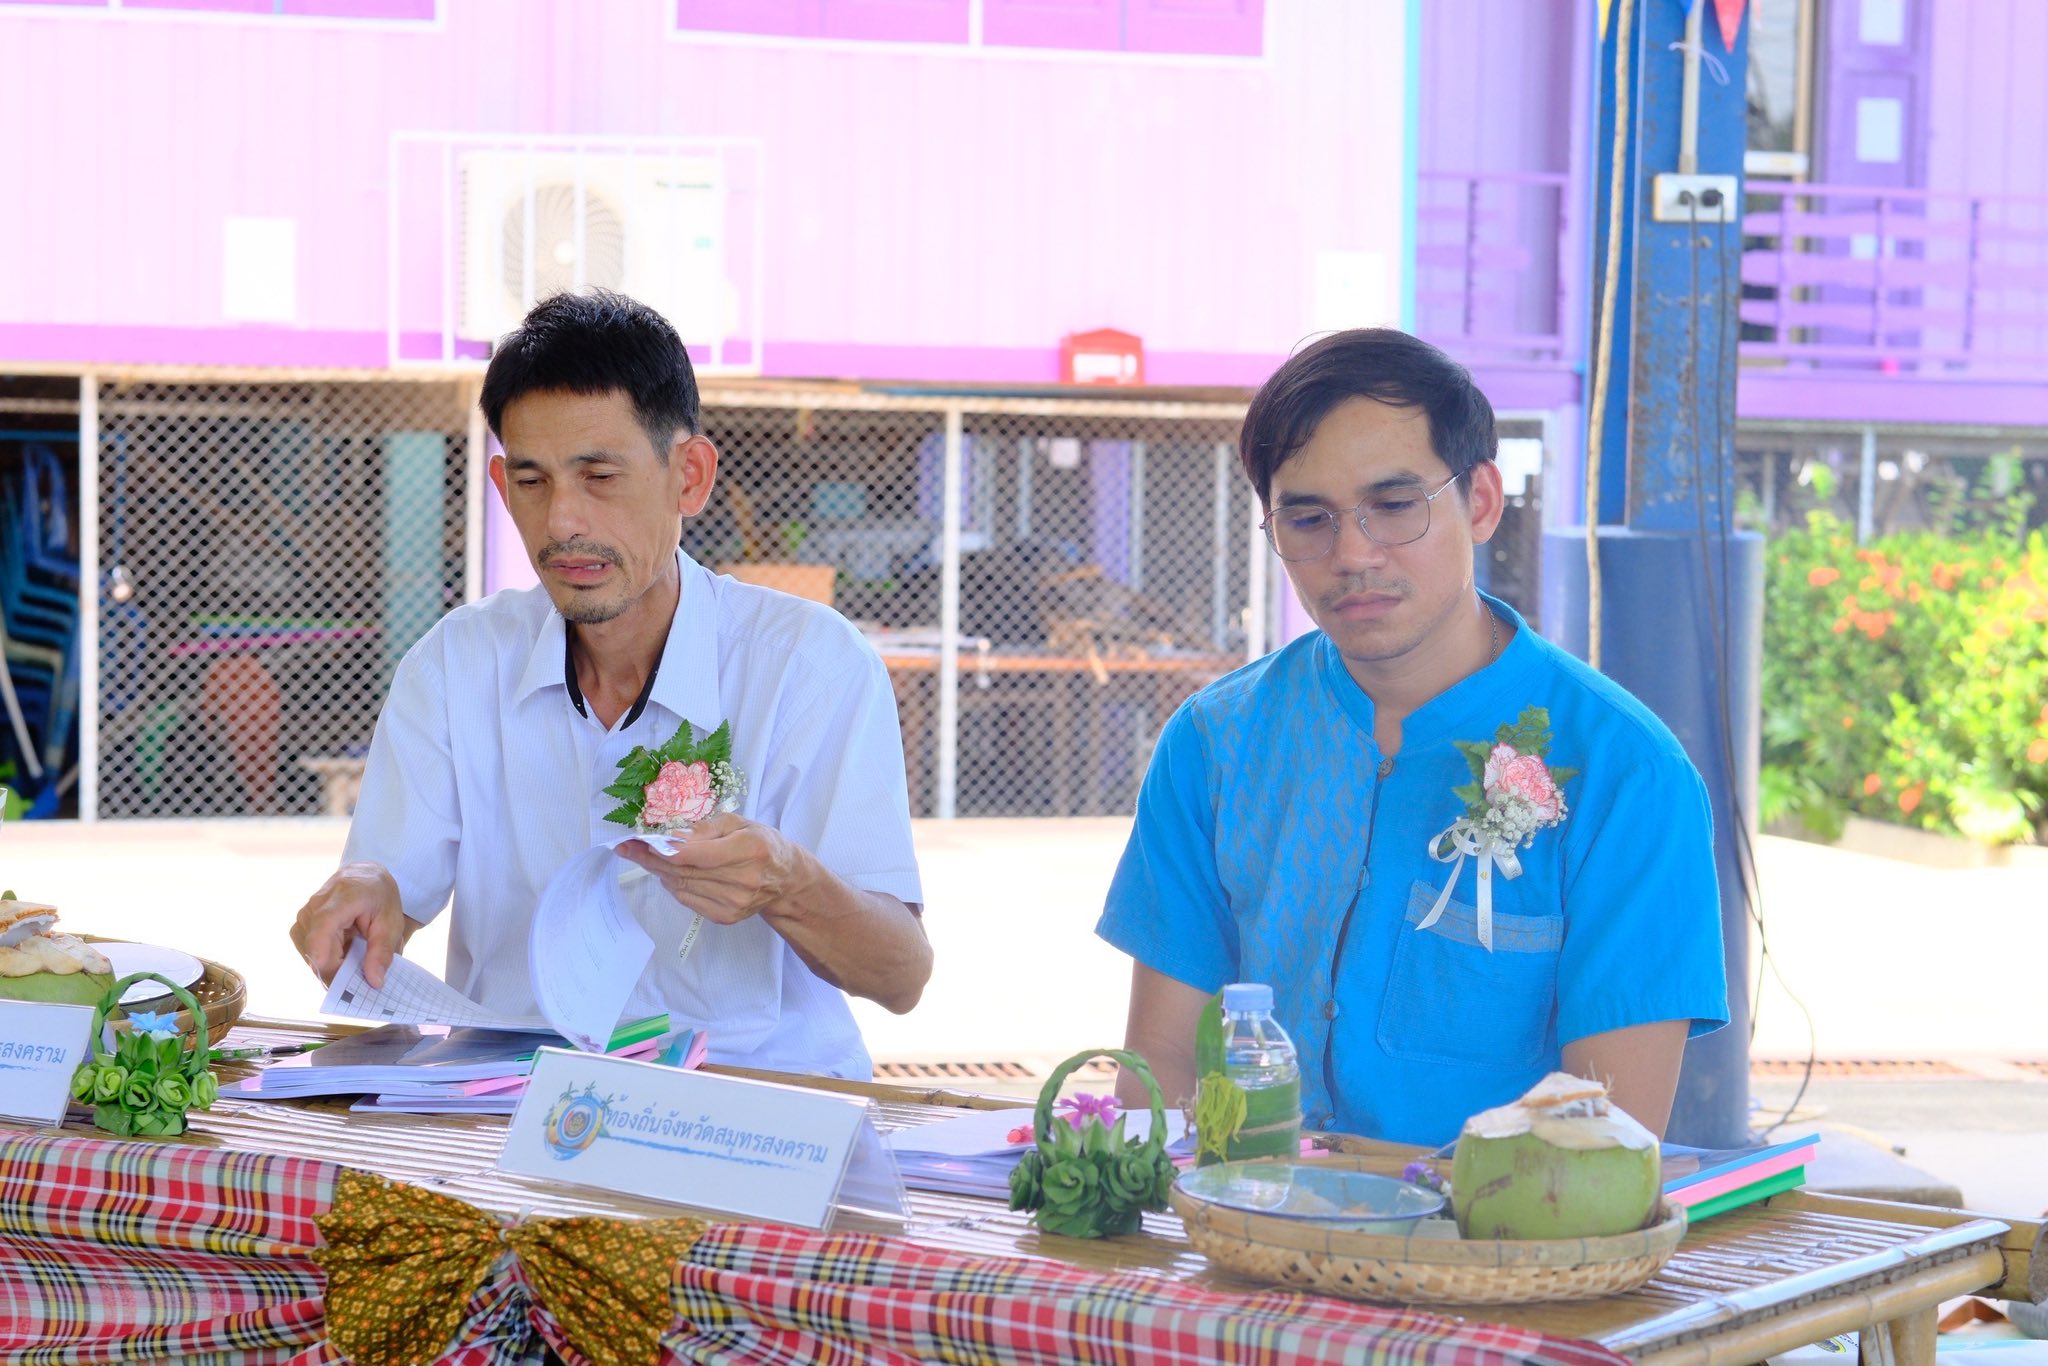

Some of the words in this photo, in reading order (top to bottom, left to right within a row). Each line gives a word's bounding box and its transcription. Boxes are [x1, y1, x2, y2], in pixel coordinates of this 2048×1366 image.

[685, 929, 697, 944] YOU
[605, 1094, 829, 1163] ท้องถิ่นจังหวัดสมุทรสงคราม
